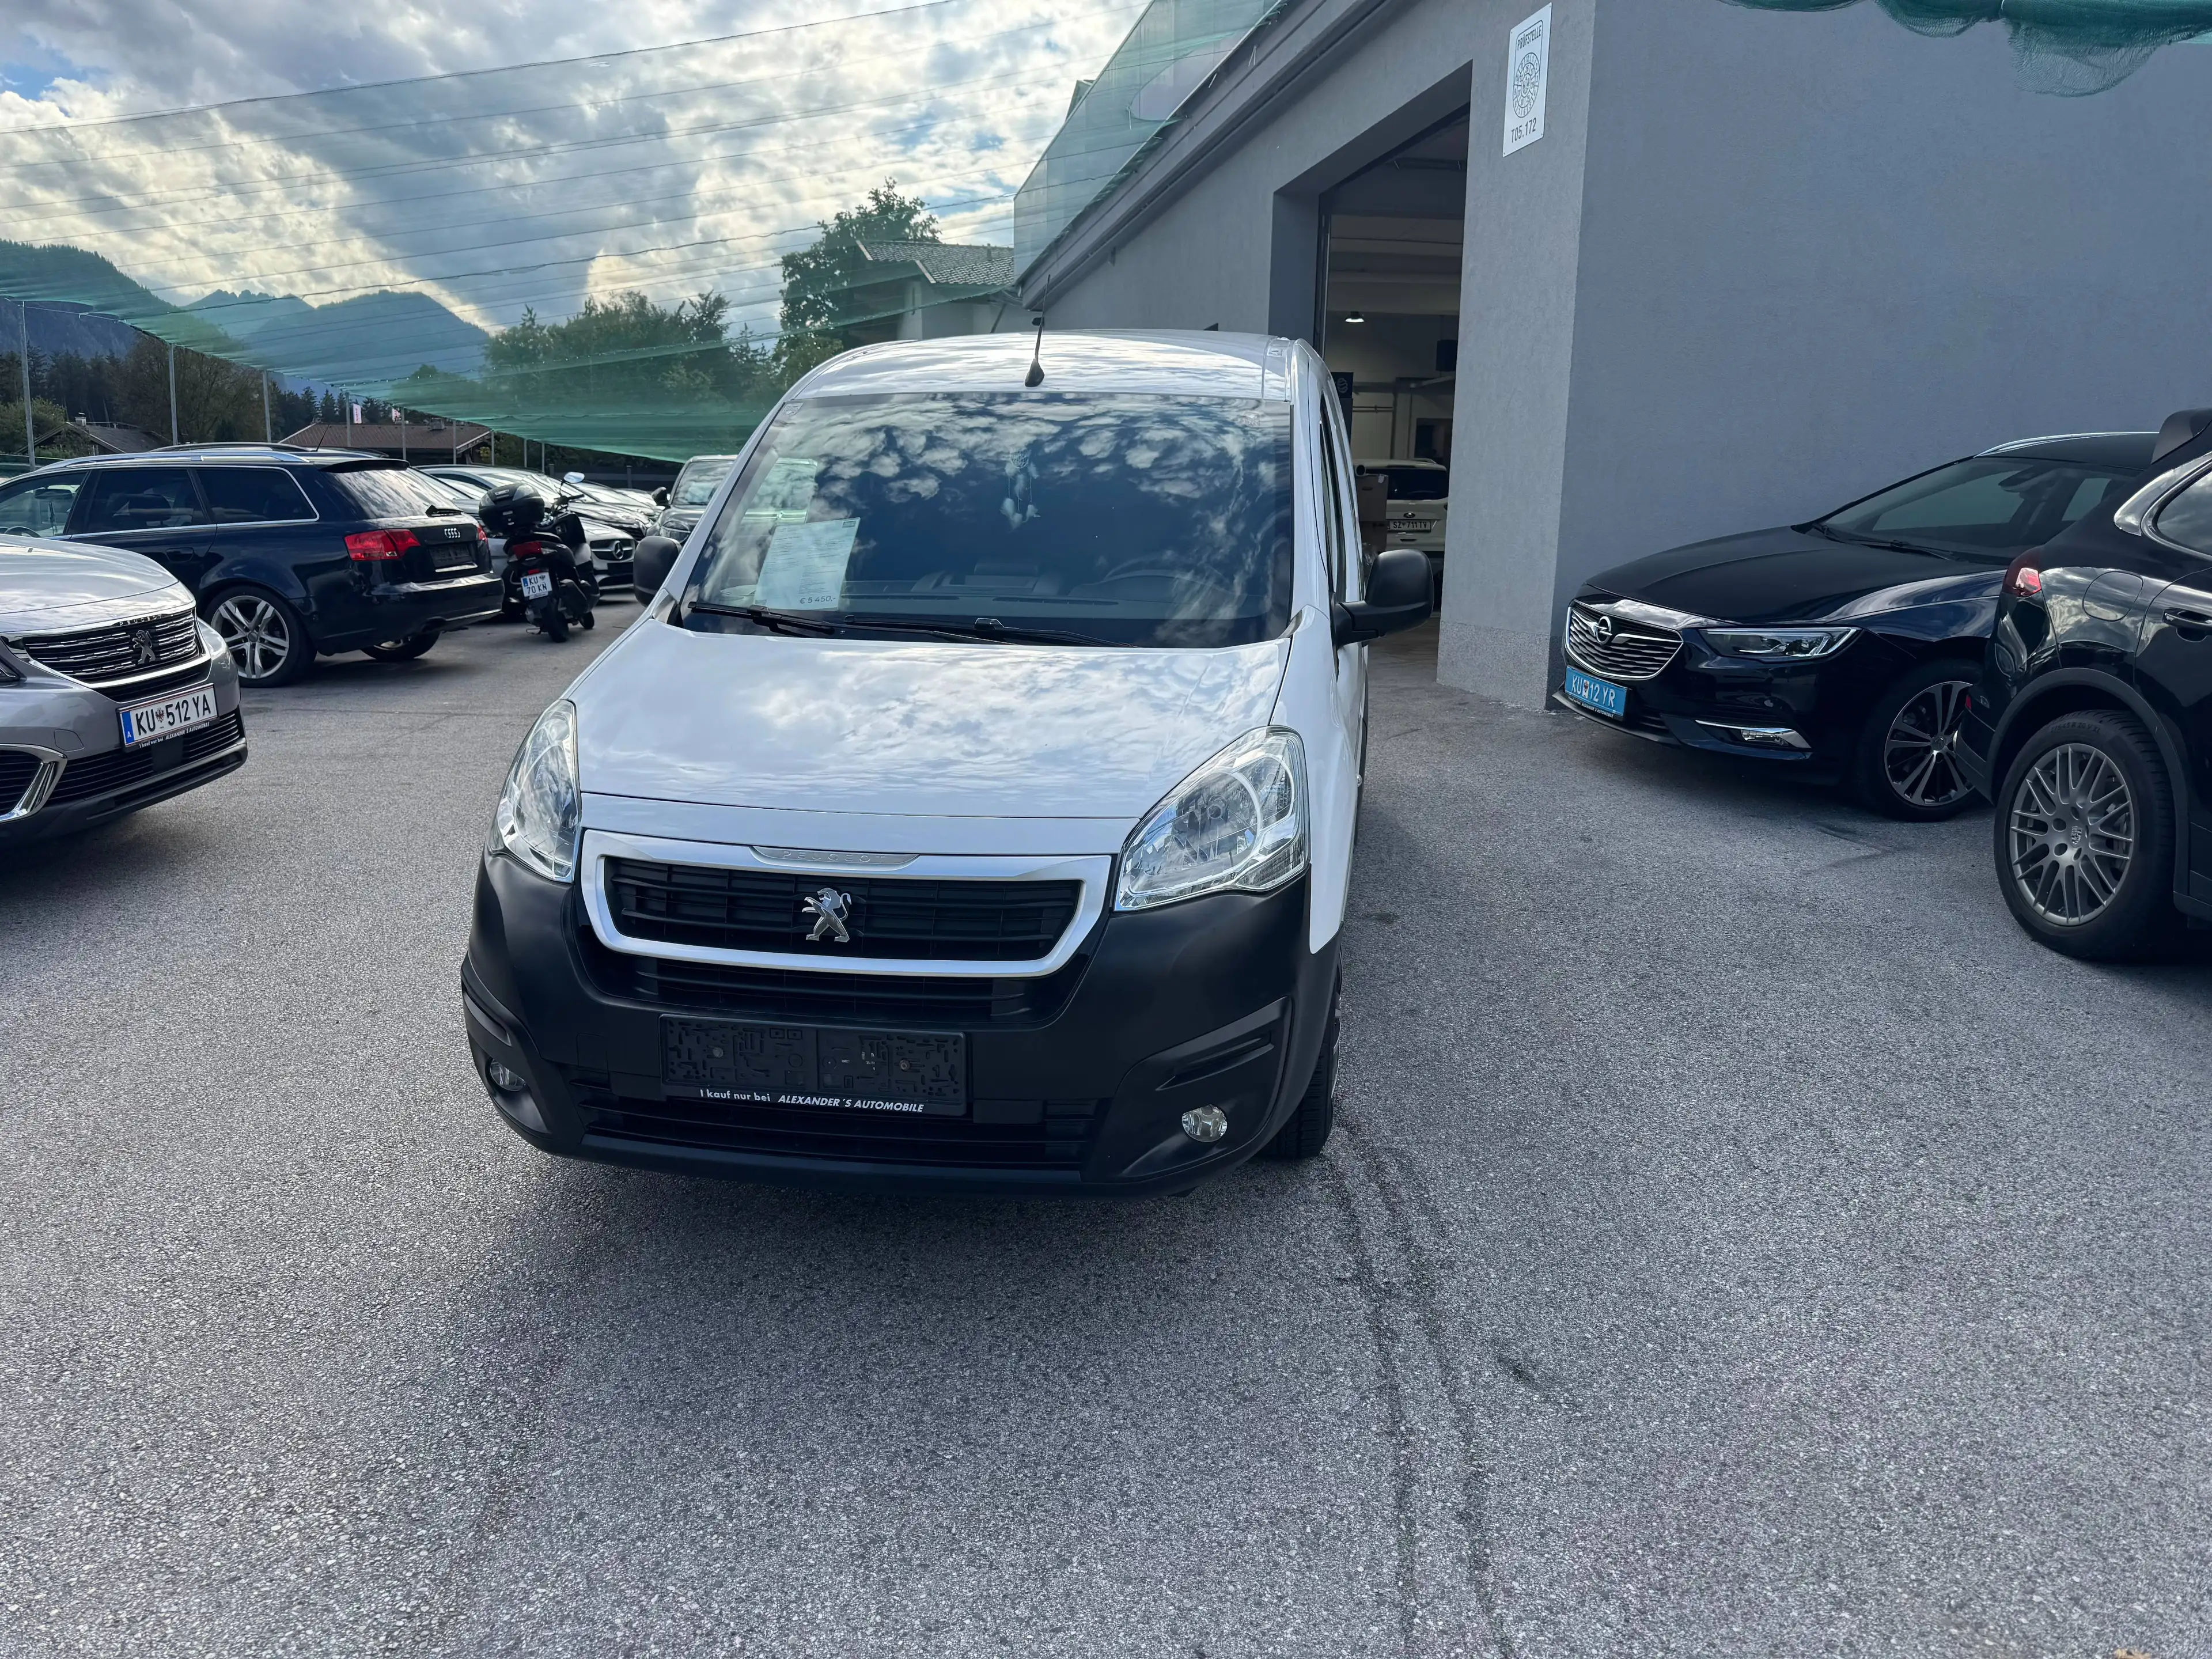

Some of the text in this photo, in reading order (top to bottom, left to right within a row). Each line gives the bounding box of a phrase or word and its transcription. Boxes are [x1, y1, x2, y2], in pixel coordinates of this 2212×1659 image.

[1517, 25, 1542, 51] PRÜFSTELLE
[1511, 117, 1537, 143] T05.172
[527, 586, 536, 594] 70
[529, 576, 538, 585] KU
[1571, 675, 1583, 695] KU
[1590, 682, 1600, 702] 12
[1603, 686, 1615, 708] YR
[135, 694, 211, 736] KU 512 YA
[783, 850, 885, 863] PEUGEOT
[700, 1089, 703, 1097] I
[706, 1090, 731, 1099] kauf
[733, 1092, 751, 1100] nur
[753, 1092, 771, 1102] bei
[778, 1094, 840, 1107] ALEXANDER
[854, 1099, 924, 1113] AUTOMOBILE
